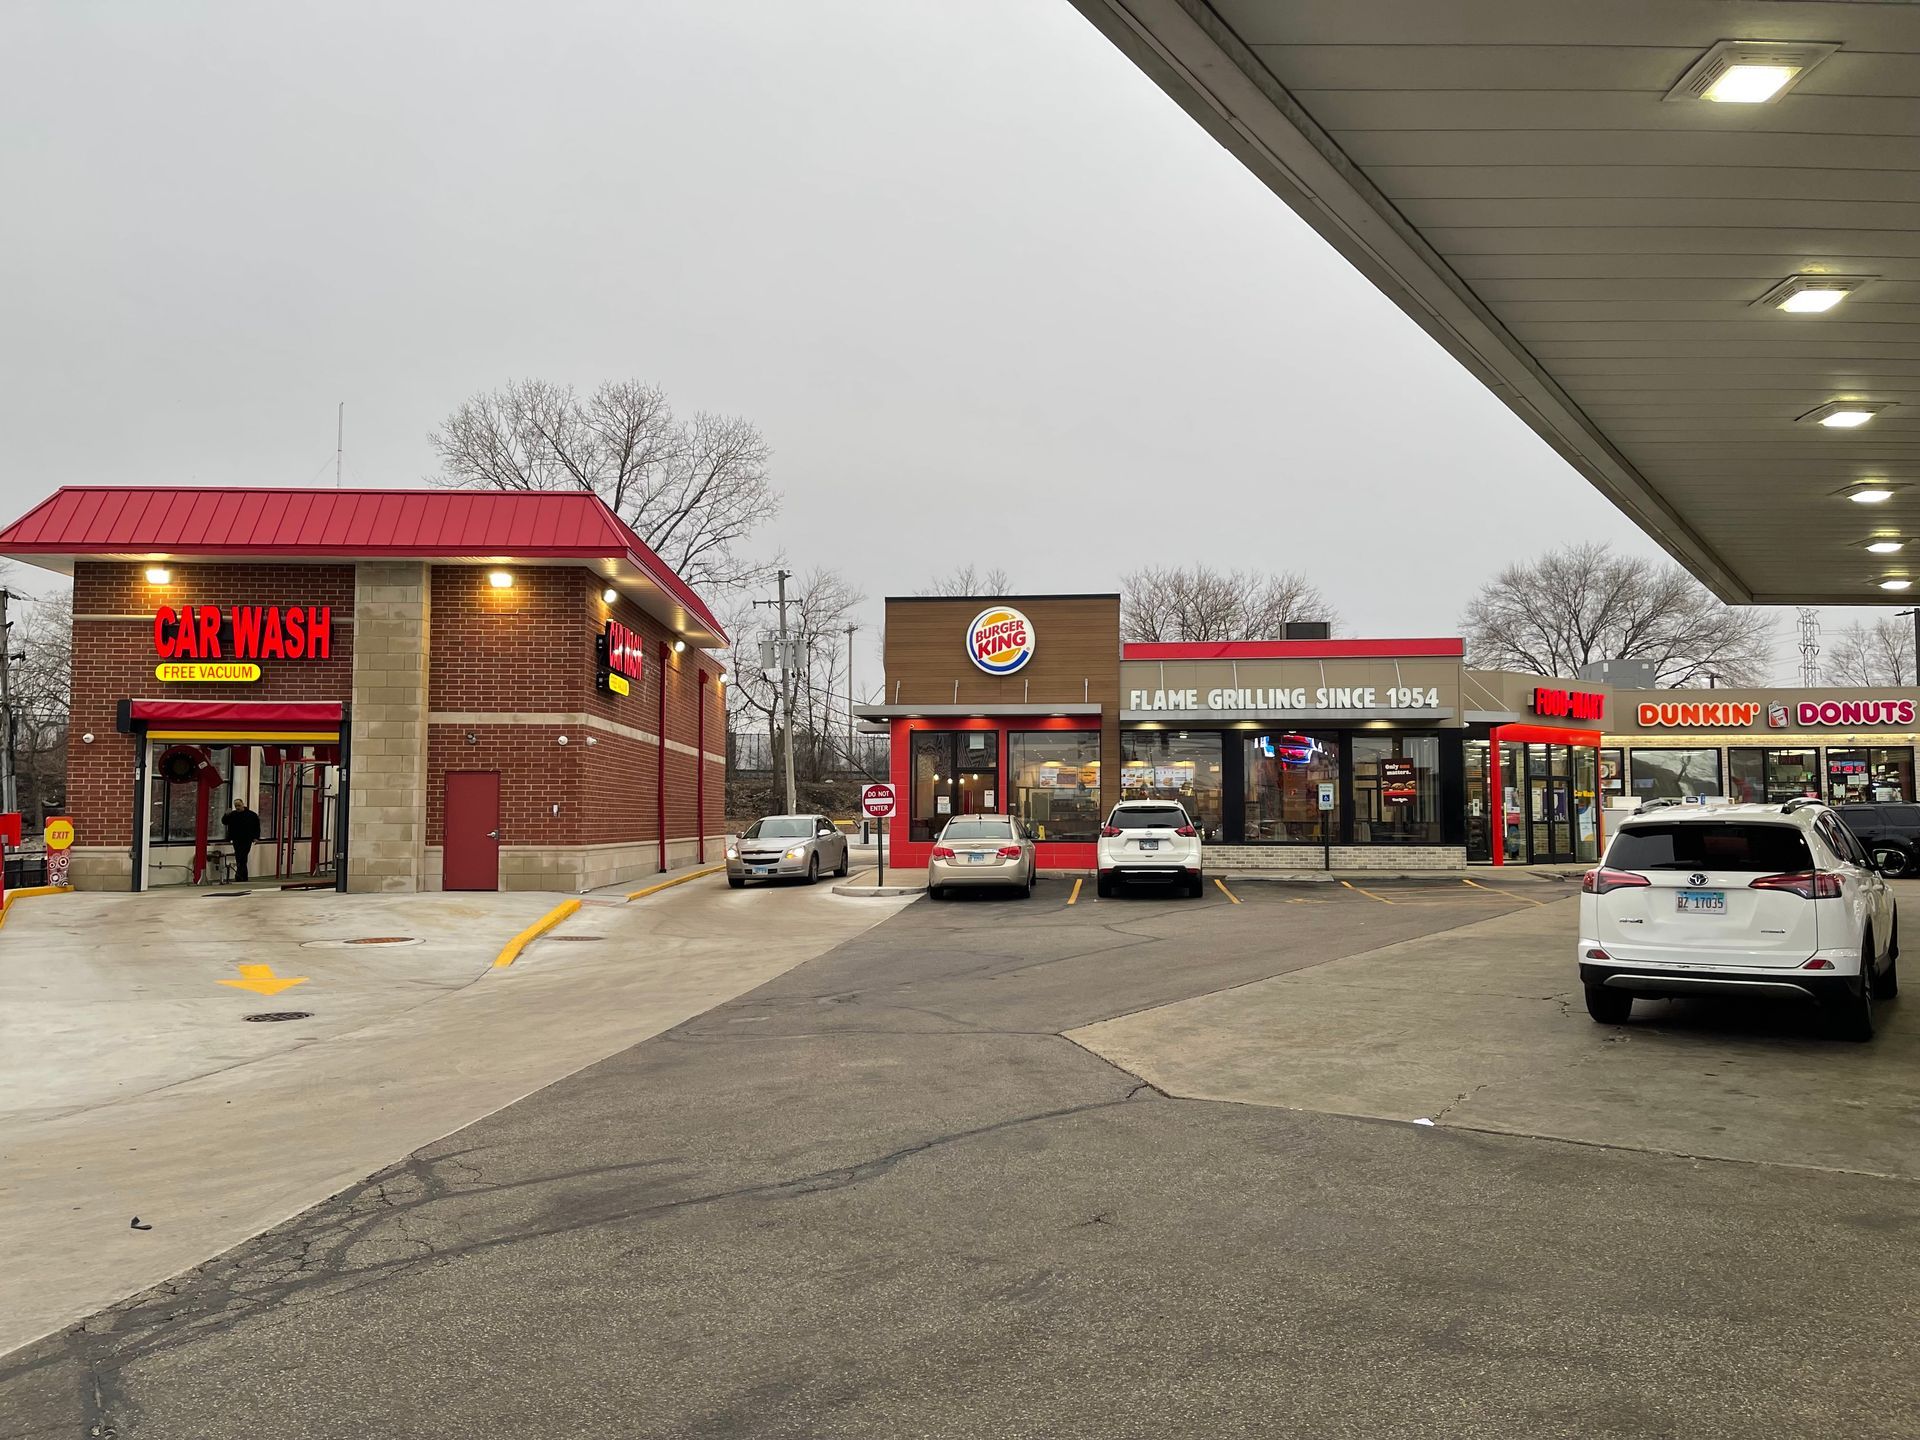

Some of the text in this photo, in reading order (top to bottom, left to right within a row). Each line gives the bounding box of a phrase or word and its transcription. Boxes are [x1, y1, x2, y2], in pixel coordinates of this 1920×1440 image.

[154, 605, 331, 659] CAR WASH
[976, 620, 1024, 643] BURGER
[978, 631, 1026, 659] KING
[163, 666, 253, 679] FREE VACUUM
[1130, 687, 1439, 710] FLAME GRILLING SINCE 1954
[1639, 701, 1914, 727] DUNKIN' DONUTS
[52, 831, 70, 840] EXIT
[1694, 897, 1723, 908] 17035
